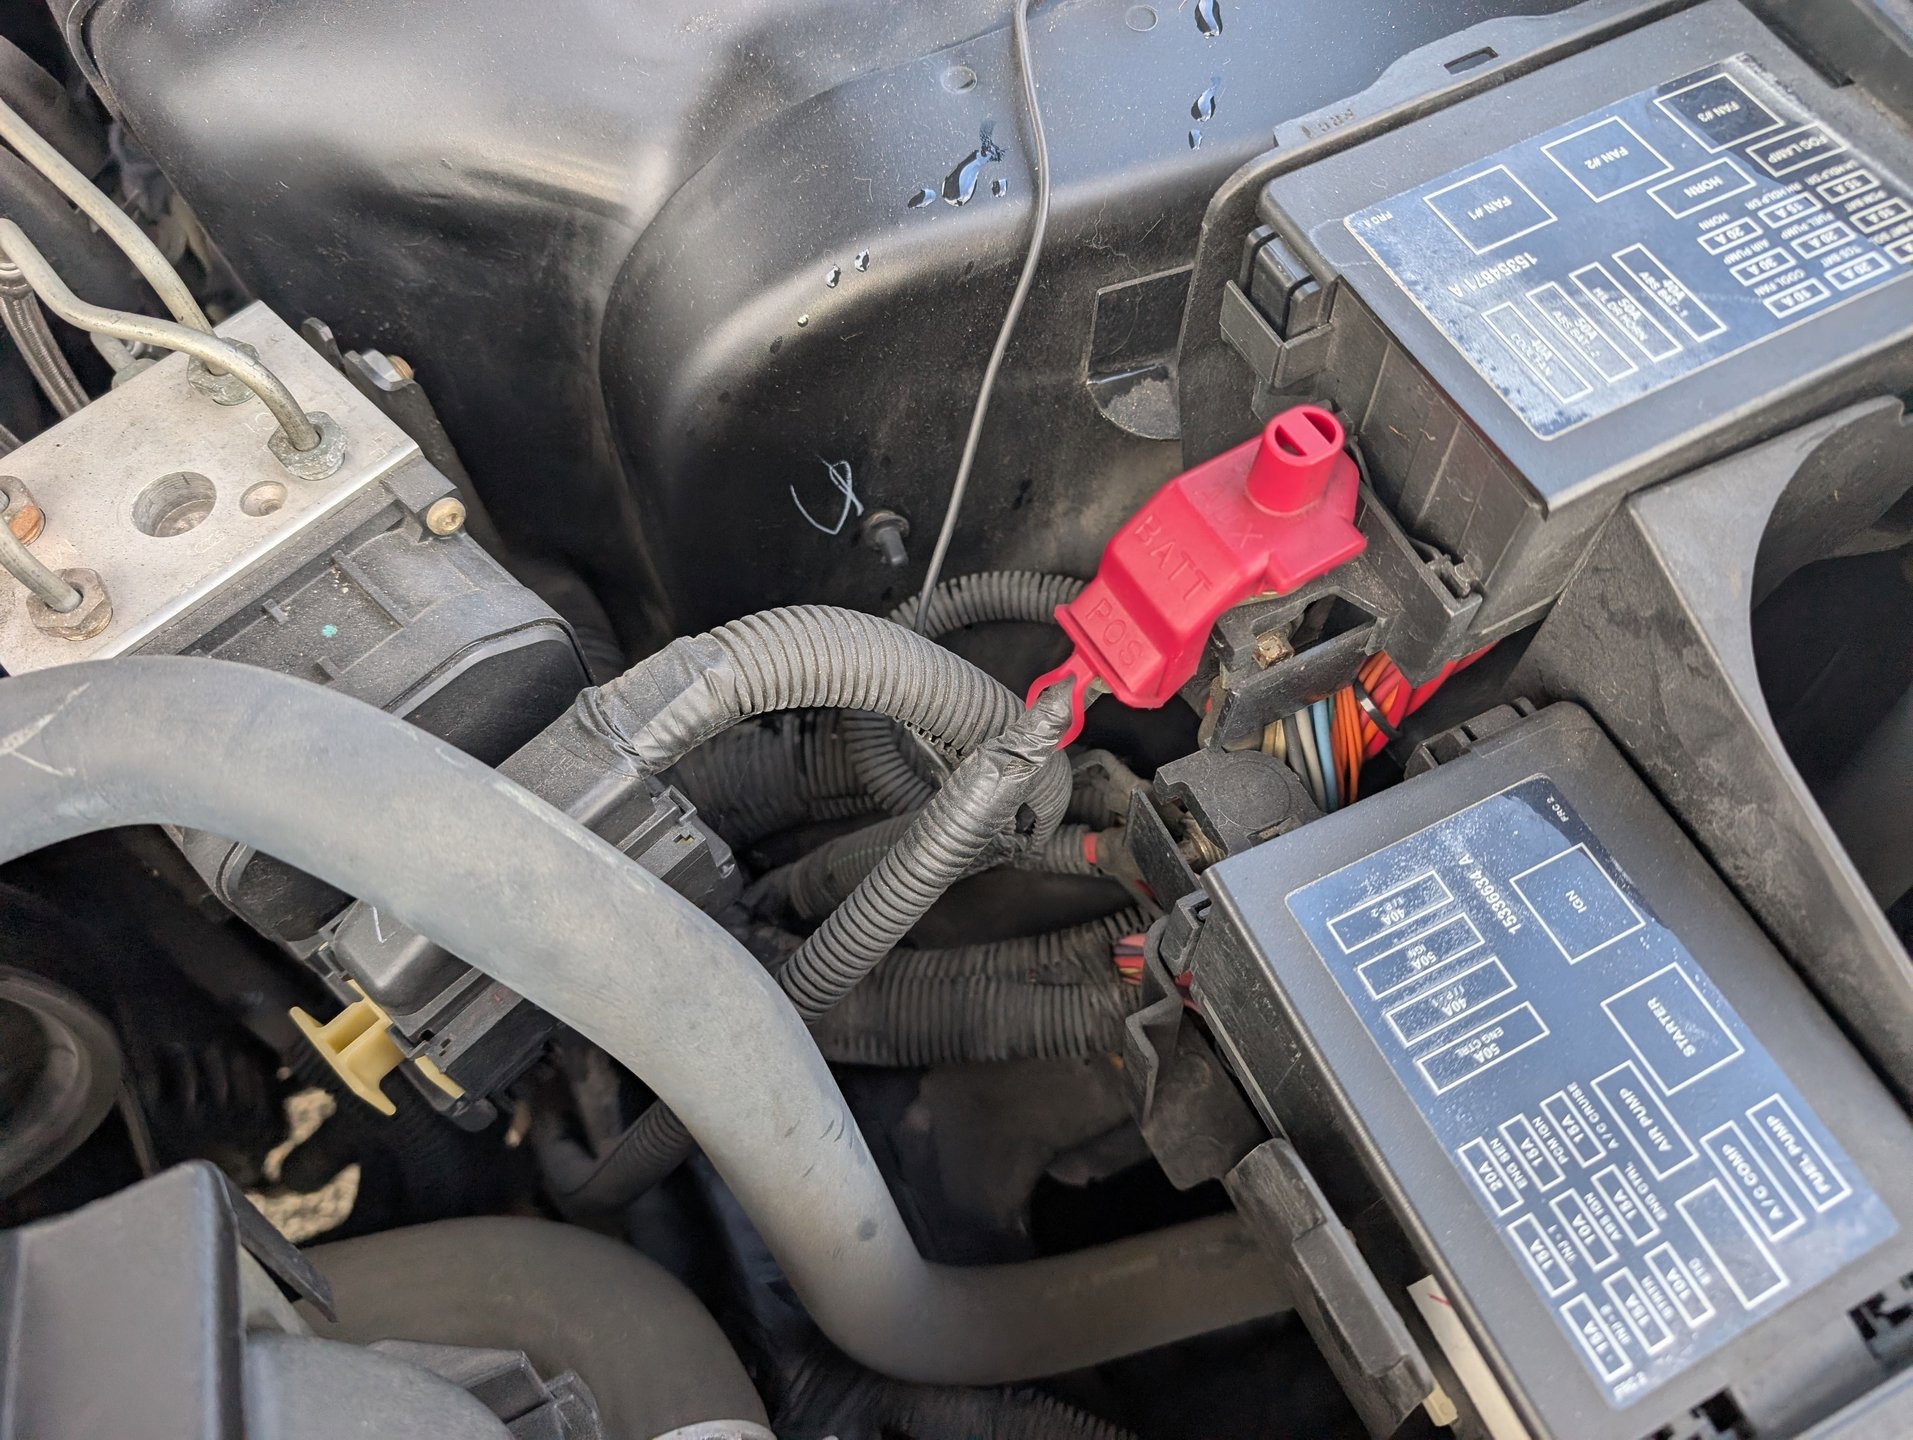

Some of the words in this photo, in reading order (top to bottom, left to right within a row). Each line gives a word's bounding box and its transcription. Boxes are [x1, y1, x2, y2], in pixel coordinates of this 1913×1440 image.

[1698, 110, 1714, 122] #3
[1713, 100, 1741, 116] FAN
[1800, 135, 1828, 150] FOG
[1585, 156, 1602, 170] #2
[1601, 146, 1628, 164] FAN
[1768, 144, 1802, 164] LAMP
[1684, 176, 1724, 198] HORN
[1832, 184, 1846, 194] A
[1467, 208, 1484, 220] #1
[1482, 196, 1512, 214] FAN
[1774, 208, 1787, 218] A
[1698, 212, 1730, 231] HORN
[1808, 211, 1835, 227] FUEL
[1866, 213, 1878, 222] A
[1714, 234, 1728, 245] A
[1727, 226, 1745, 240] 20
[1781, 223, 1810, 240] PUMP
[1821, 230, 1838, 244] 20
[1752, 238, 1770, 252] AIR
[1808, 237, 1821, 248] A
[1724, 248, 1753, 265] PUMP
[1760, 256, 1779, 270] 30
[1747, 263, 1760, 275] A
[1776, 268, 1806, 286] COOL
[1842, 268, 1855, 279] A
[1448, 284, 1464, 298] A
[1638, 271, 1660, 292] ABS
[1662, 279, 1686, 300] 40A
[1754, 281, 1778, 297] FAN
[1618, 298, 1641, 320] 50A
[1781, 296, 1795, 307] A
[1574, 318, 1598, 340] 50A
[1136, 516, 1212, 600] BATT
[1086, 598, 1142, 667] POS
[1458, 854, 1474, 866] A
[1469, 870, 1522, 935] 15336634
[1566, 890, 1587, 914] IGN
[1381, 908, 1406, 926] 40A
[1406, 944, 1426, 959] IGN
[1411, 952, 1436, 970] 50A
[1442, 998, 1467, 1016] 40A
[1482, 1026, 1504, 1046] ENG
[1648, 997, 1696, 1058] STARTER
[1455, 1038, 1484, 1058] CTRL
[1472, 1043, 1500, 1064] 50A
[1567, 1082, 1600, 1122] CRUISE
[1618, 1088, 1654, 1128] PUMP
[1532, 1116, 1552, 1138] IGN
[1562, 1114, 1584, 1143] 15A
[1766, 1116, 1802, 1156] PUMP
[1648, 1127, 1673, 1152] AIR
[1490, 1138, 1510, 1164] SEN
[1521, 1137, 1544, 1166] 15A
[1548, 1137, 1570, 1165] PCM
[1722, 1144, 1760, 1187] COMP
[1798, 1153, 1831, 1194] FUEL
[1479, 1161, 1503, 1192] 20A
[1506, 1162, 1528, 1190] ENG
[1624, 1161, 1649, 1195] CTRL
[1584, 1192, 1604, 1216] IGN
[1614, 1188, 1637, 1220] 15A
[1645, 1192, 1668, 1222] ENG
[1572, 1214, 1596, 1246] 10A
[1600, 1216, 1622, 1240] ABS
[1530, 1238, 1554, 1270] 15A
[1666, 1267, 1692, 1300] 10A
[1625, 1292, 1650, 1327] 15A
[1583, 1319, 1609, 1352] 15A
